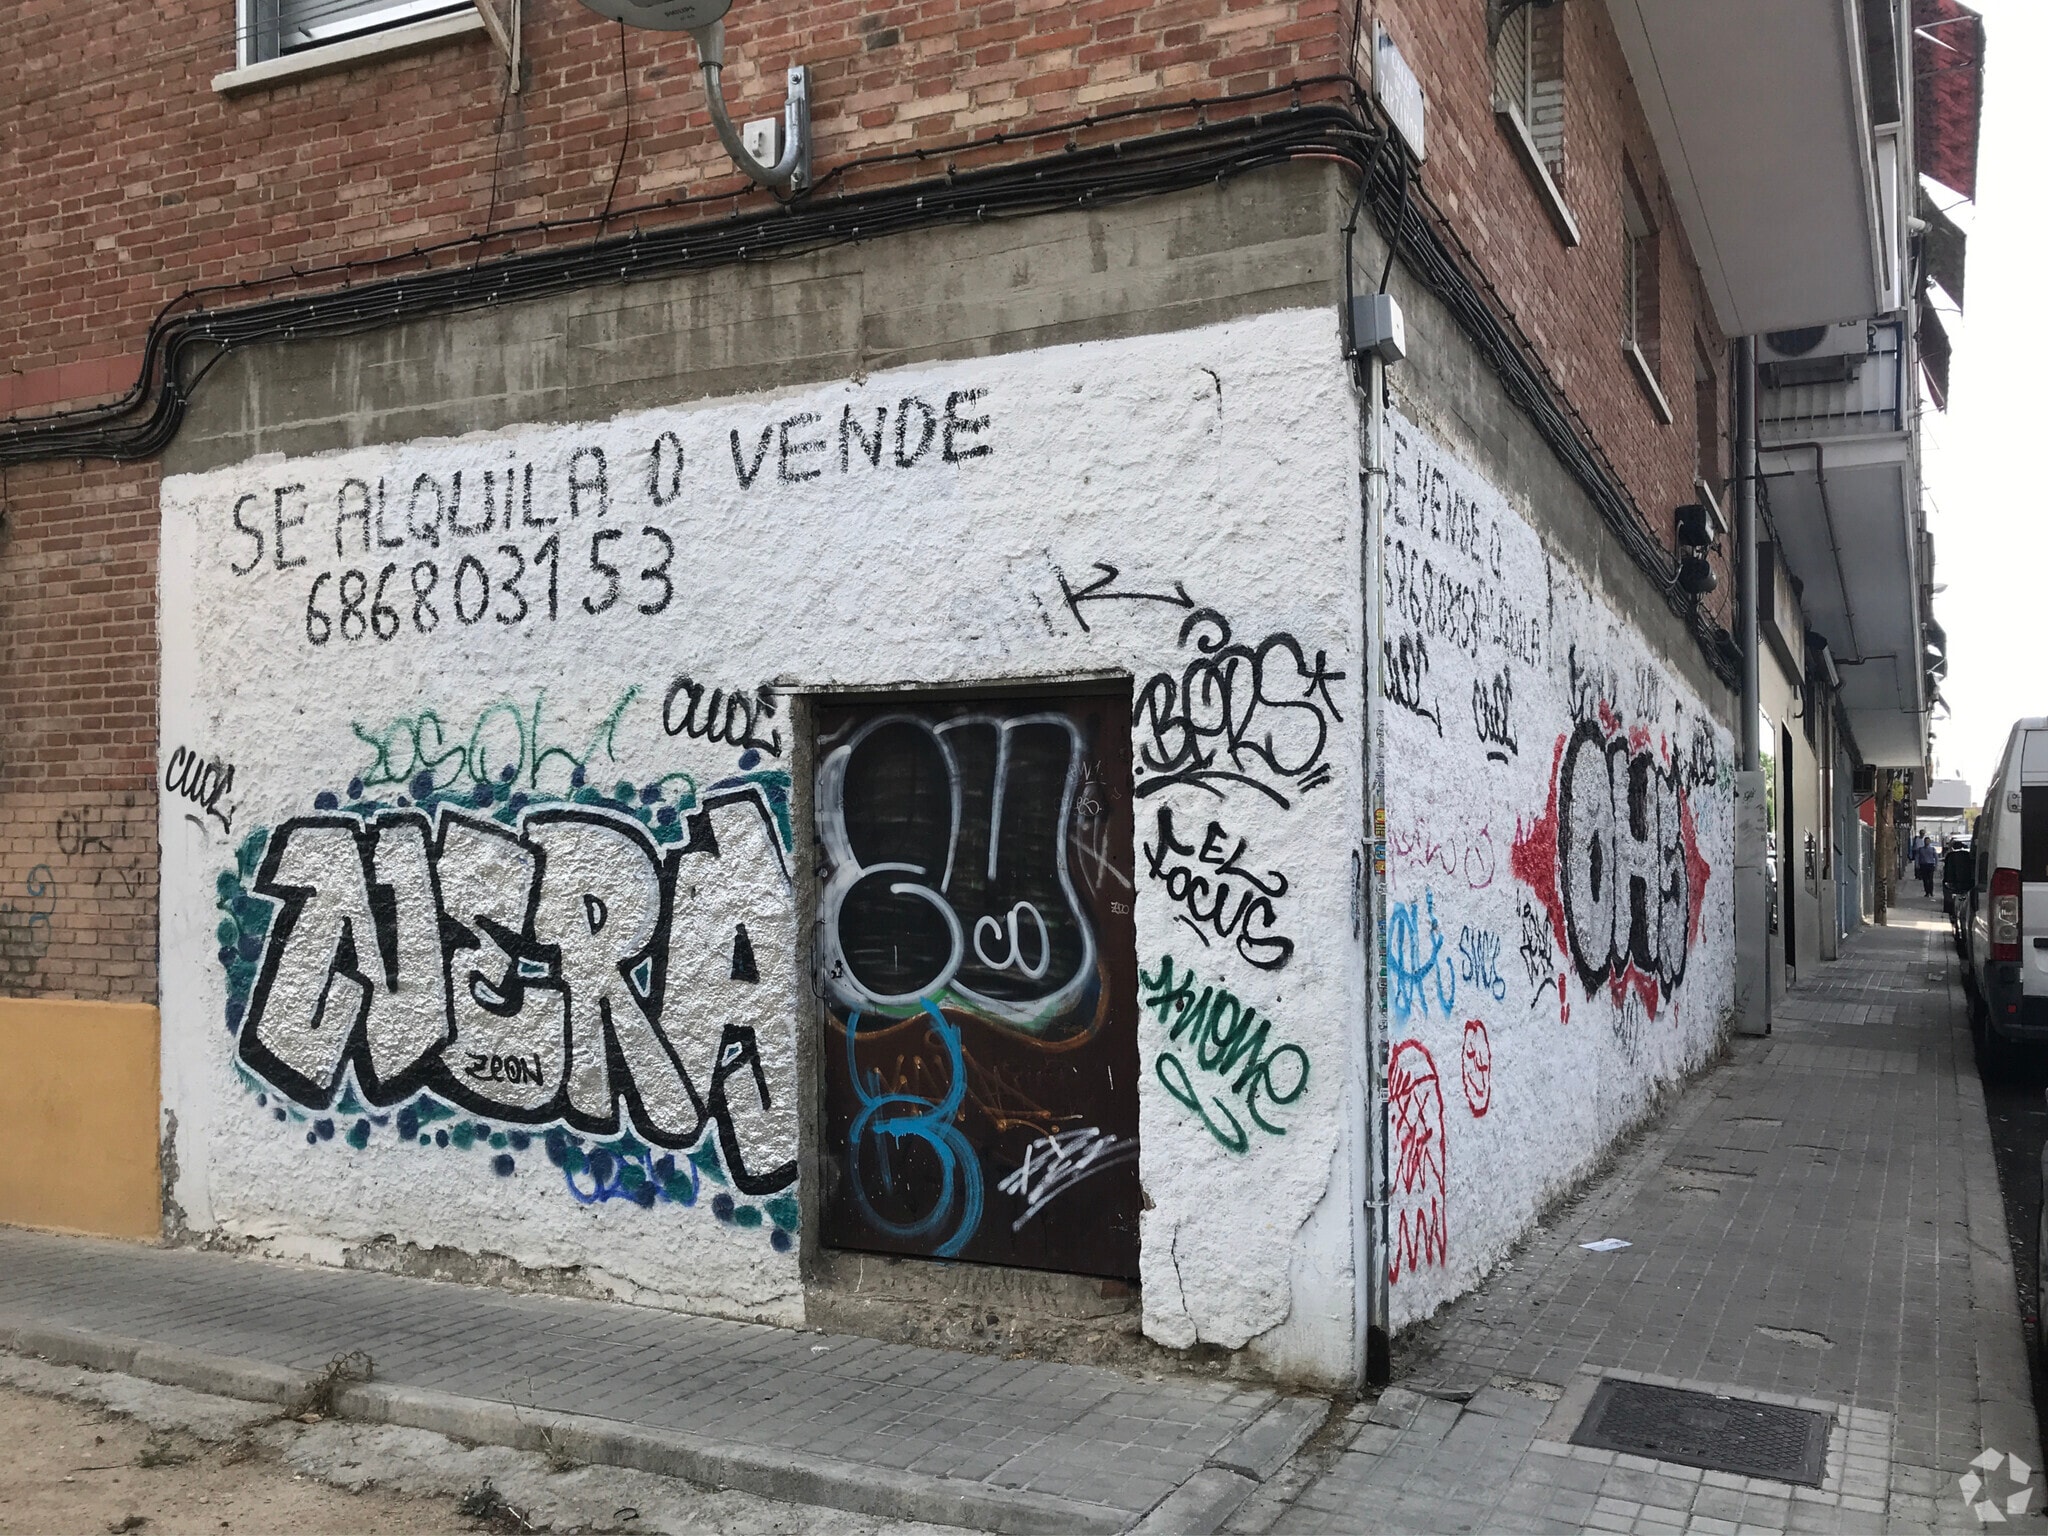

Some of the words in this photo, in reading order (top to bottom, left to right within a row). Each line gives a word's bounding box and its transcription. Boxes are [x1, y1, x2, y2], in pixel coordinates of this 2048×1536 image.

[231, 484, 306, 576] SE
[731, 388, 993, 490] VENDE
[306, 526, 675, 646] 686803153
